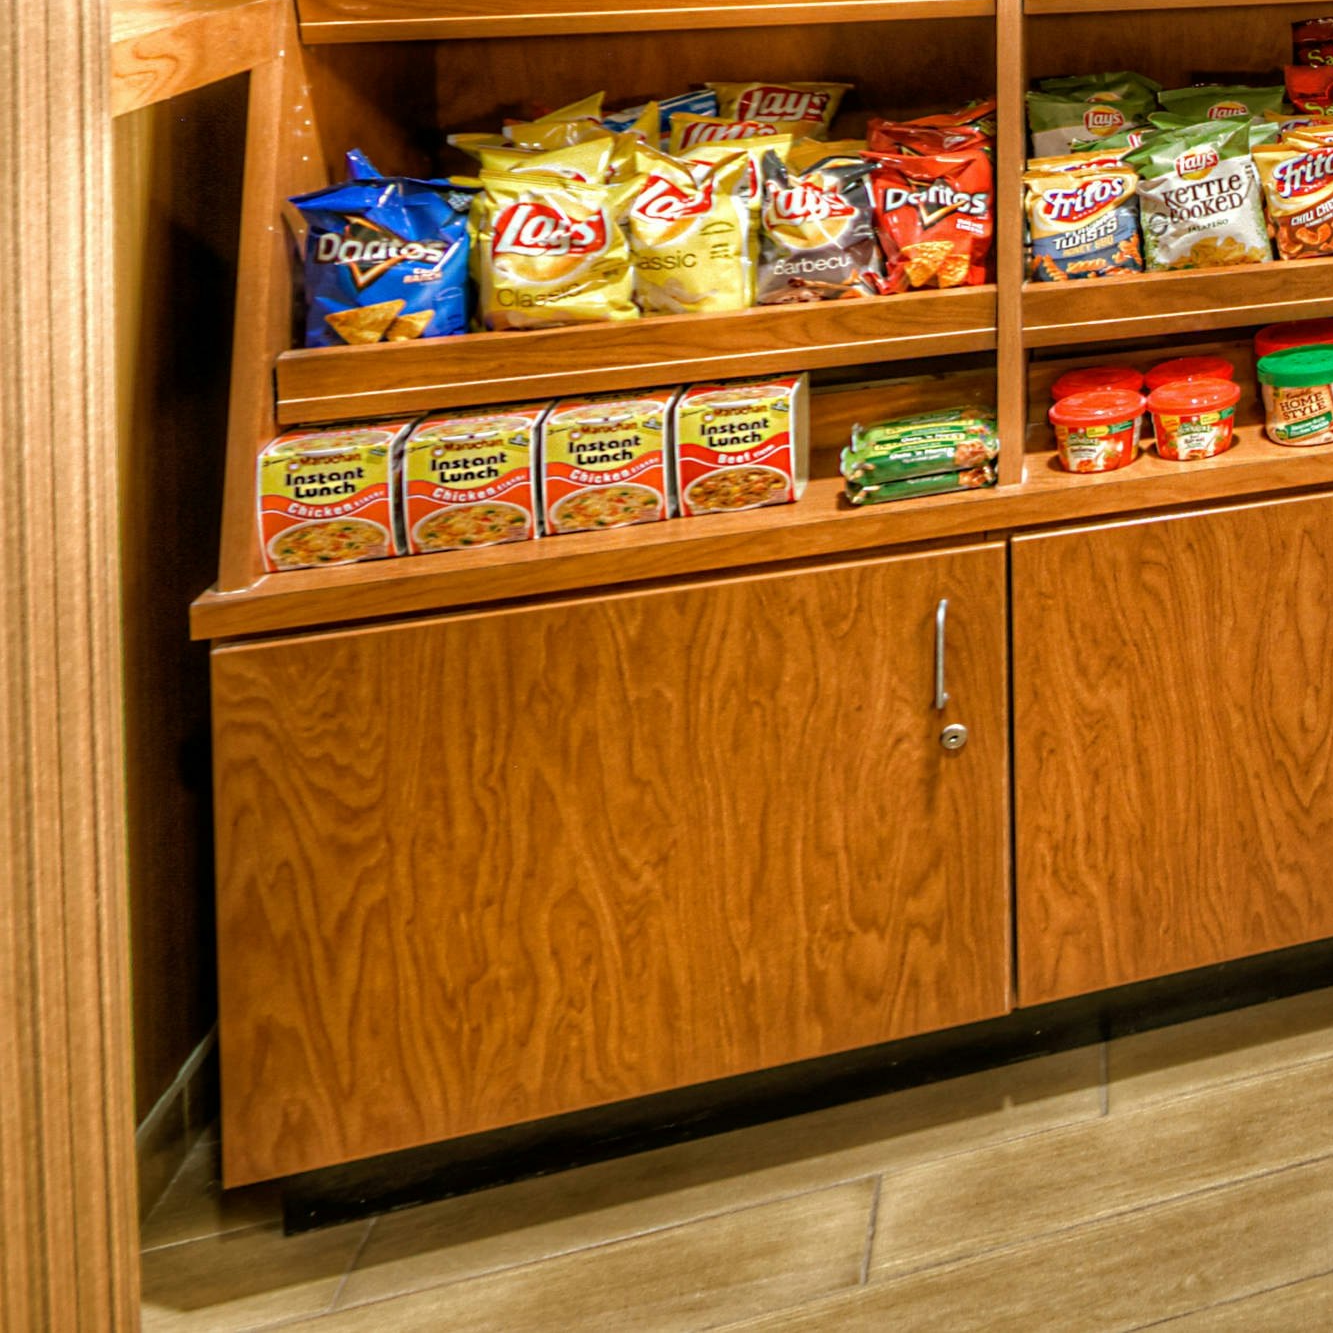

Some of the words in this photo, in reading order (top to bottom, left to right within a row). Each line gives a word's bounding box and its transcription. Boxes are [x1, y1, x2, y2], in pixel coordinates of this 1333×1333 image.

[885, 185, 988, 214] Doritos
[1043, 178, 1124, 220] Fritos
[1163, 174, 1243, 209] KETTLE
[1171, 192, 1244, 224] COOKED
[1291, 209, 1317, 226] CHILI
[1052, 216, 1118, 250] TWISTS
[317, 233, 449, 264] Doritos
[773, 254, 852, 277] Barbecu
[497, 283, 582, 308] Classic
[1280, 392, 1323, 411] HOME
[1283, 402, 1326, 421] STYLE
[701, 418, 769, 436] Instant
[569, 435, 641, 453] Instant
[708, 432, 762, 448] Lunch
[432, 452, 507, 471] Instant
[577, 449, 633, 465] Lunch
[718, 452, 750, 465] Beef
[286, 468, 364, 485] Instant
[440, 467, 499, 483] Lunch
[569, 469, 630, 485] Chicken
[294, 483, 355, 498] Lunch
[433, 486, 495, 503] Chicken
[287, 502, 352, 518] Chicken
